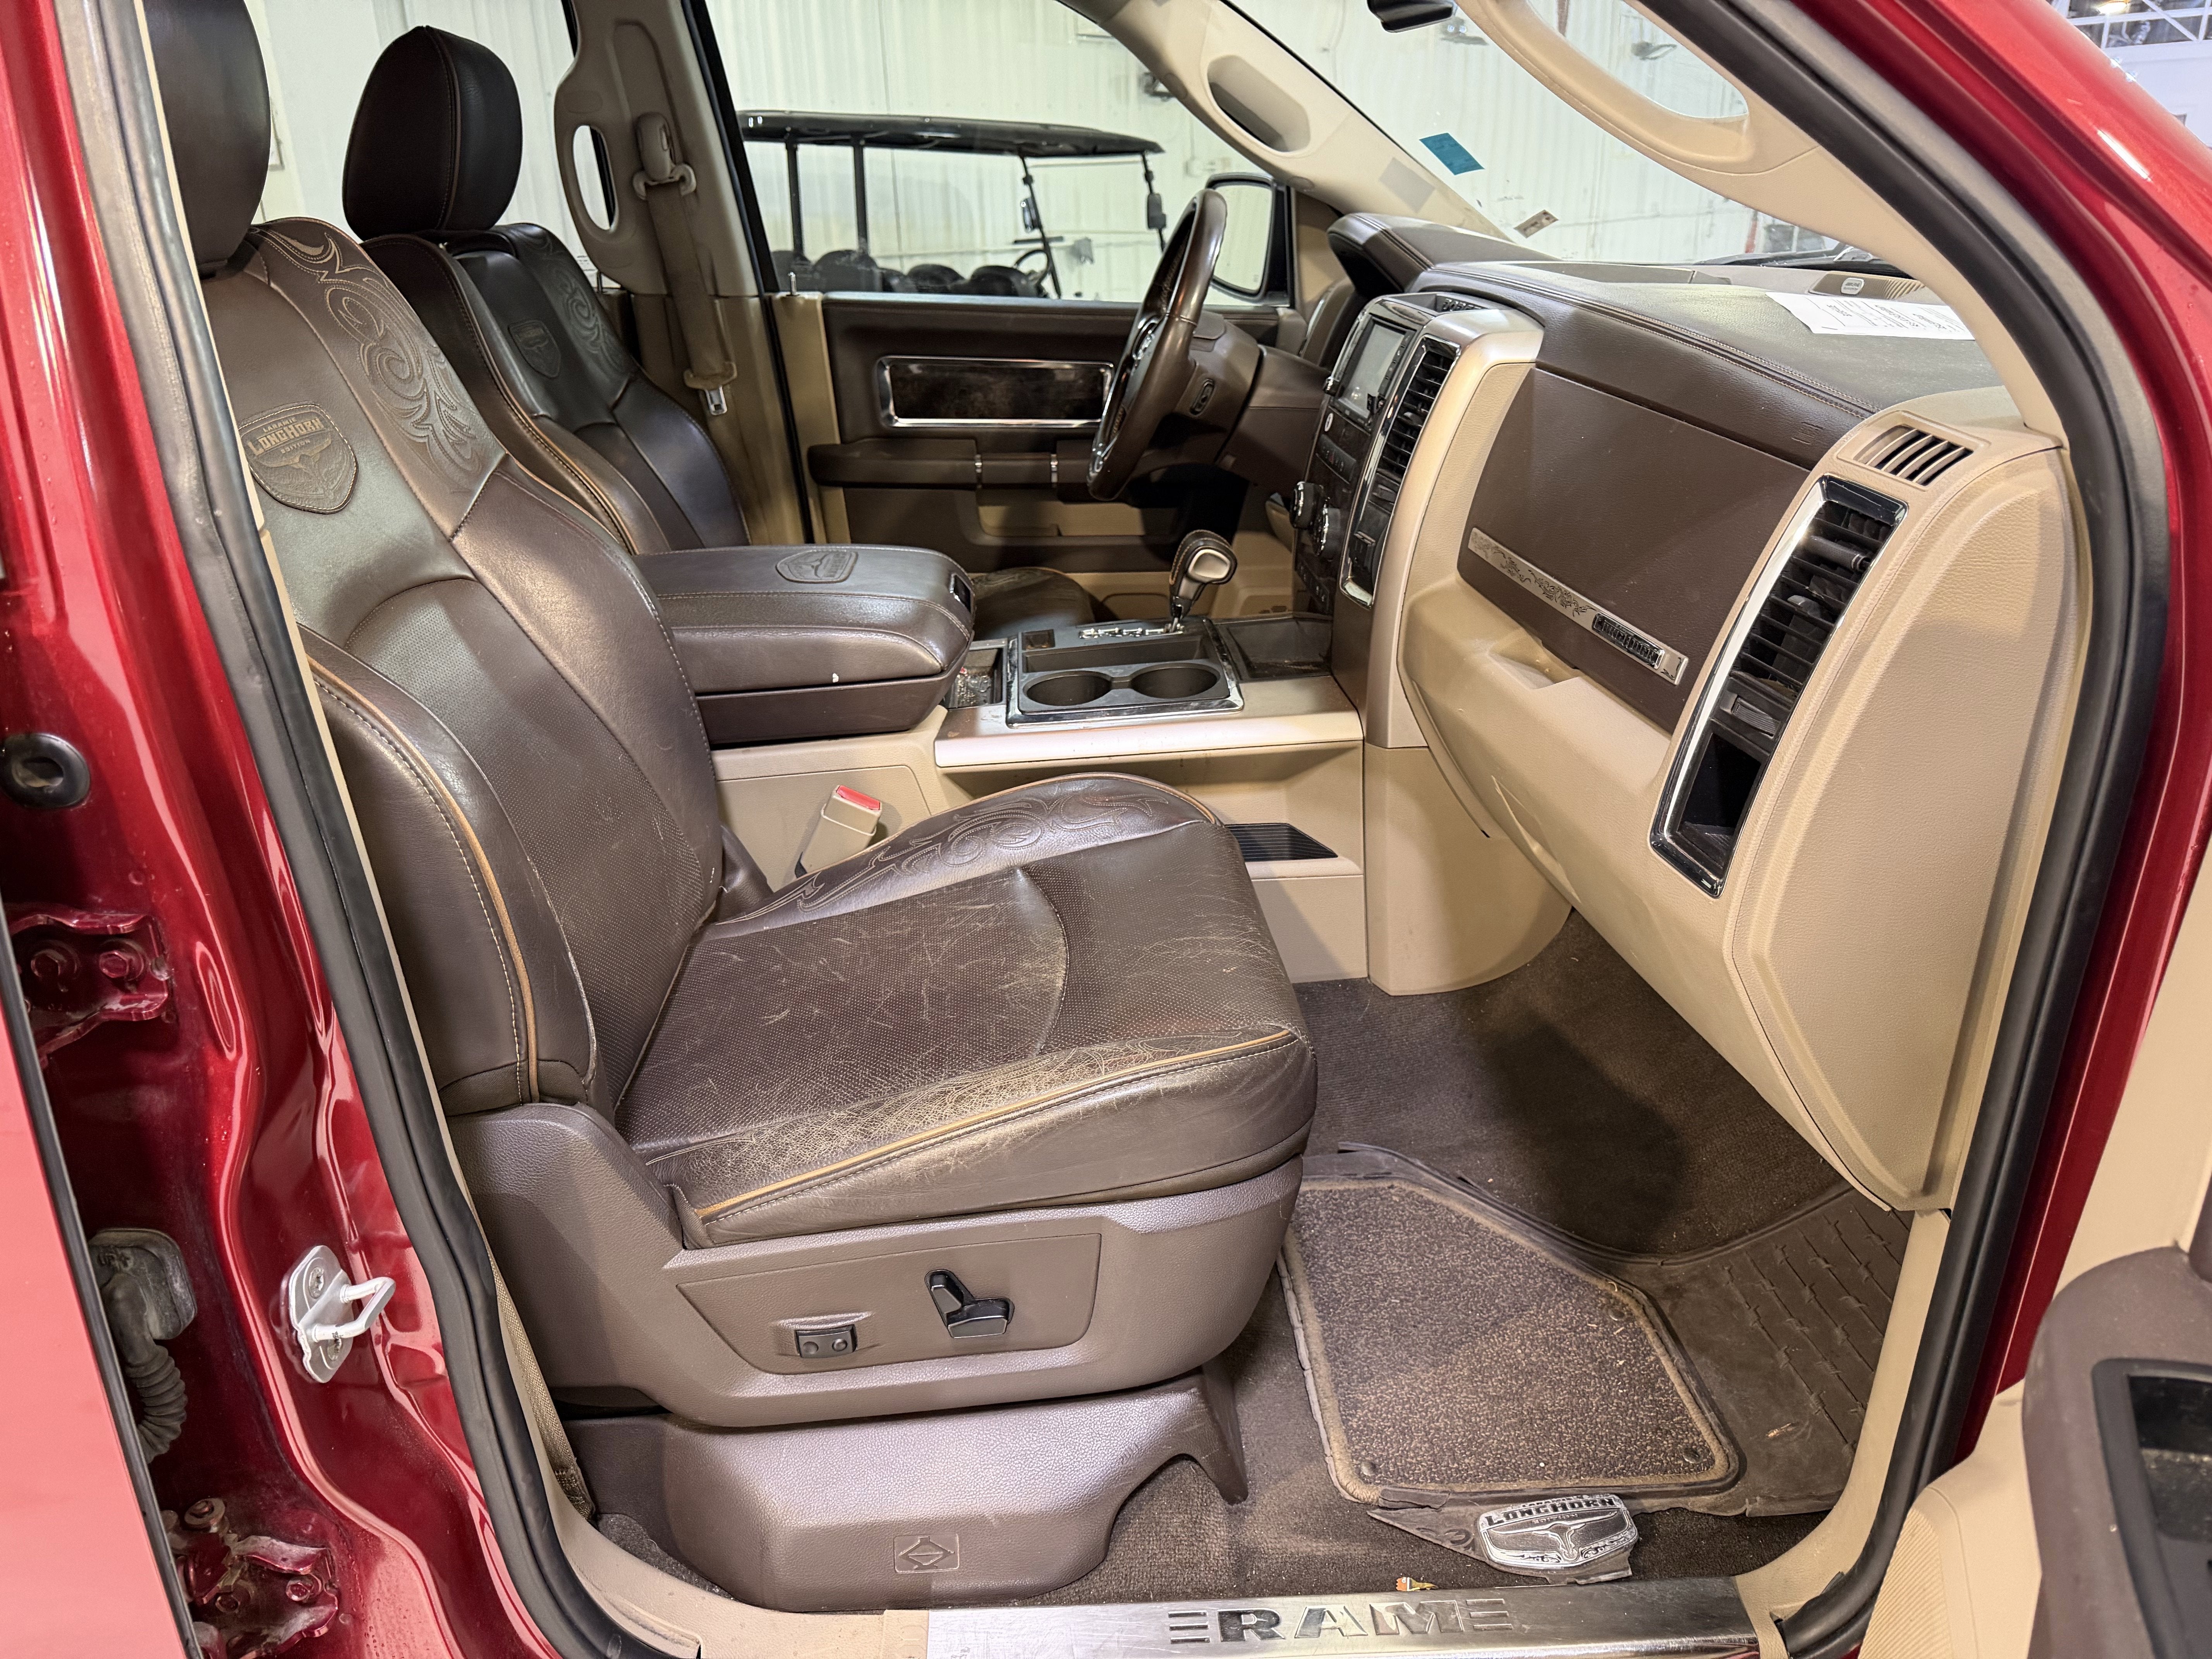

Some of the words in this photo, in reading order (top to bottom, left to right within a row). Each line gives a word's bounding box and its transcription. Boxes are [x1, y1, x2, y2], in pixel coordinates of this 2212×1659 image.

[247, 417, 324, 455] LONGHORN
[263, 417, 297, 433] LARAMIE
[281, 439, 310, 453] EDITION
[1485, 1497, 1616, 1526] LONGHORN
[1217, 1600, 1465, 1642] RAM
